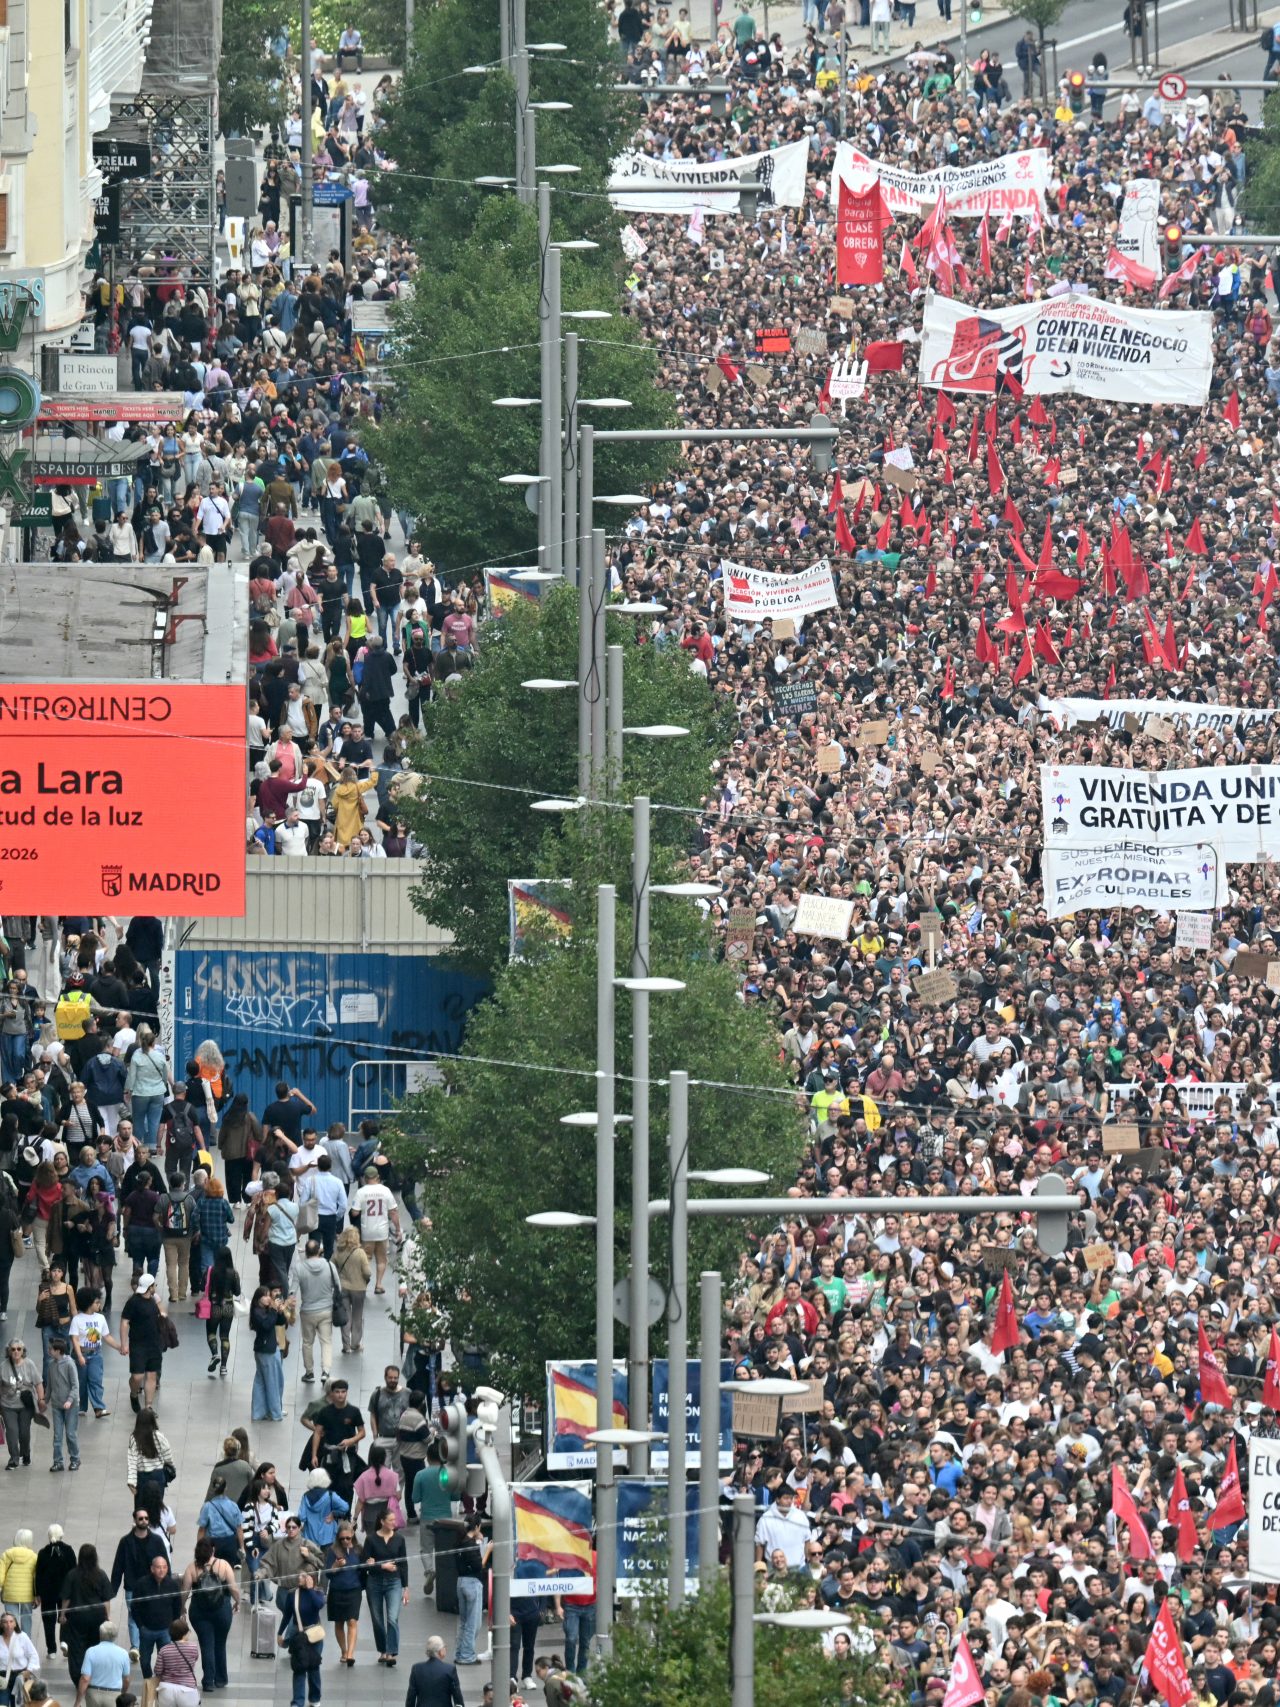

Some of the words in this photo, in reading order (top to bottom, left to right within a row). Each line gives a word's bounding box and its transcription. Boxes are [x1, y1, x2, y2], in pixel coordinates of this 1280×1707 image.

[631, 162, 646, 176] DE
[654, 167, 669, 181] LA
[671, 170, 739, 185] VIVIENDA
[845, 221, 873, 233] CLASE
[843, 236, 878, 250] OBRERA
[1036, 319, 1099, 340] CONTRA
[1100, 325, 1119, 341] EL
[1120, 329, 1189, 353] NEGOCIO
[1036, 337, 1057, 353] DE
[1059, 338, 1078, 354] LA
[1082, 339, 1152, 364] VIVIENDA
[63, 364, 74, 374] El
[77, 364, 114, 375] Rincón
[62, 380, 73, 391] de
[75, 381, 97, 391] Gran
[755, 594, 802, 608] PÚBLICA
[1196, 712, 1233, 732] POR
[38, 762, 123, 794] Lara
[1079, 777, 1213, 806] VIVIENDA
[43, 806, 73, 825] de
[82, 806, 100, 825] la
[109, 806, 143, 825] luz
[1079, 805, 1206, 832] GRATUITA
[1210, 803, 1228, 824] Y
[1237, 803, 1272, 825] DE
[1, 848, 38, 860] 2026
[1060, 849, 1089, 861] SUS
[1094, 841, 1183, 858] BENEFICIOS
[129, 873, 220, 895] MADRID
[1056, 867, 1192, 892] EXPROPIAR
[1057, 896, 1066, 905] A
[1095, 885, 1192, 899] CULPABLES
[366, 1199, 383, 1216] 21
[1254, 1455, 1273, 1477] El
[623, 1558, 634, 1569] 12
[538, 1583, 574, 1592] MADRID
